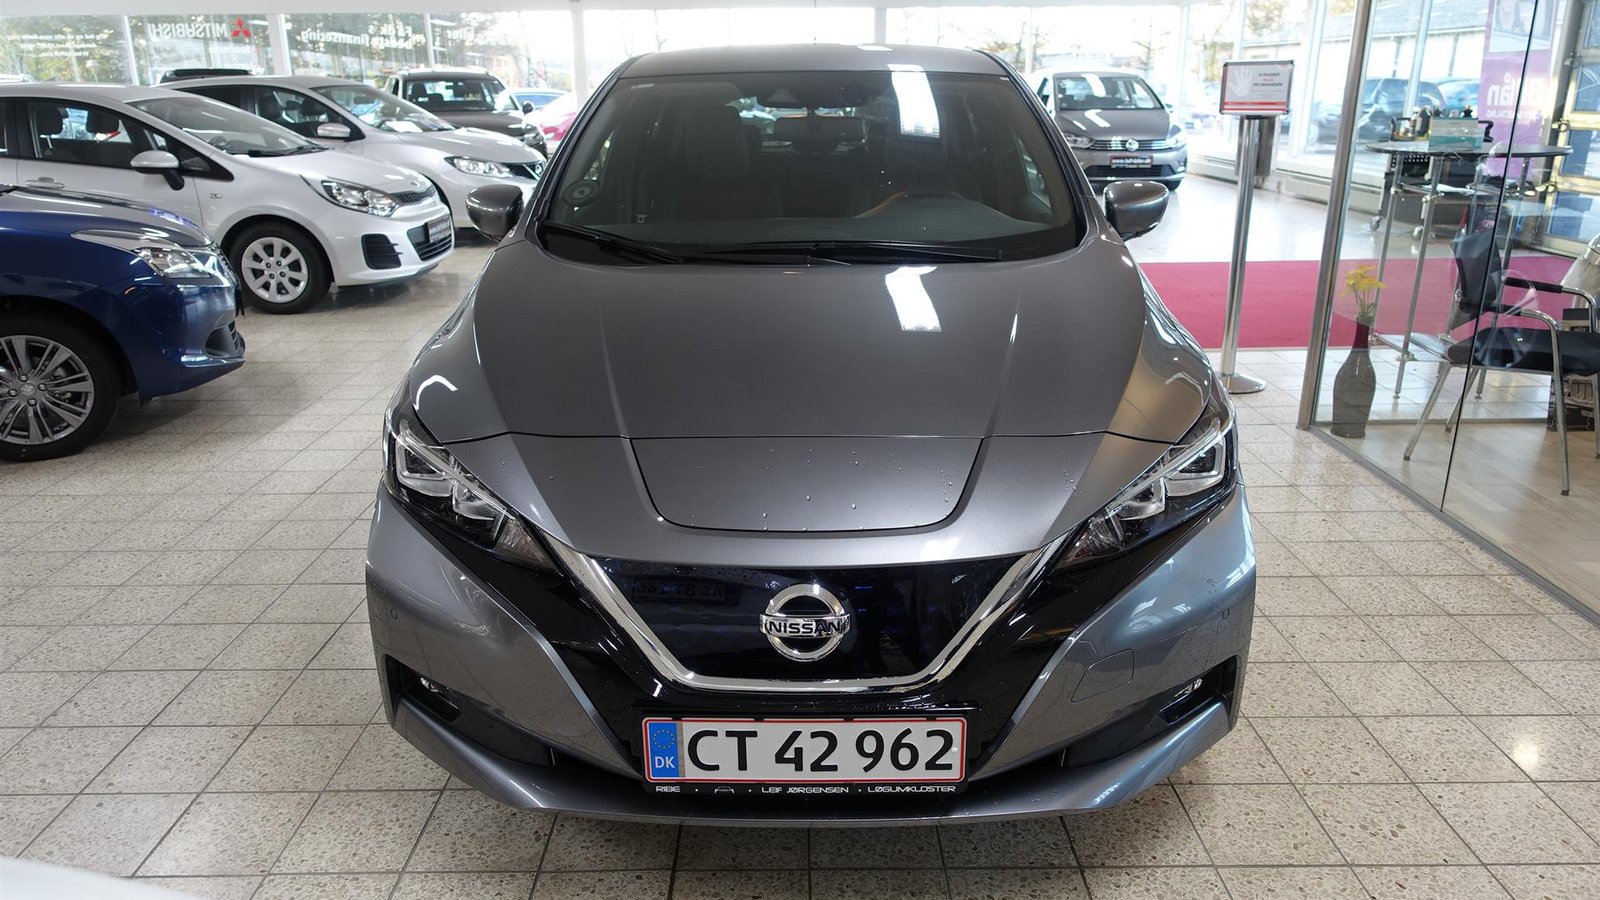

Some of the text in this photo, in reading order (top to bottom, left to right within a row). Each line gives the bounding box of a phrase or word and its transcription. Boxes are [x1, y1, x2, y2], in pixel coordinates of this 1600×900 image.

[768, 620, 841, 635] NISSAN
[687, 727, 954, 773] CT 42 962
[654, 756, 675, 769] DK
[655, 785, 956, 794] RIBE LEIF JØRGENSEN LØGUMKLOSTER
